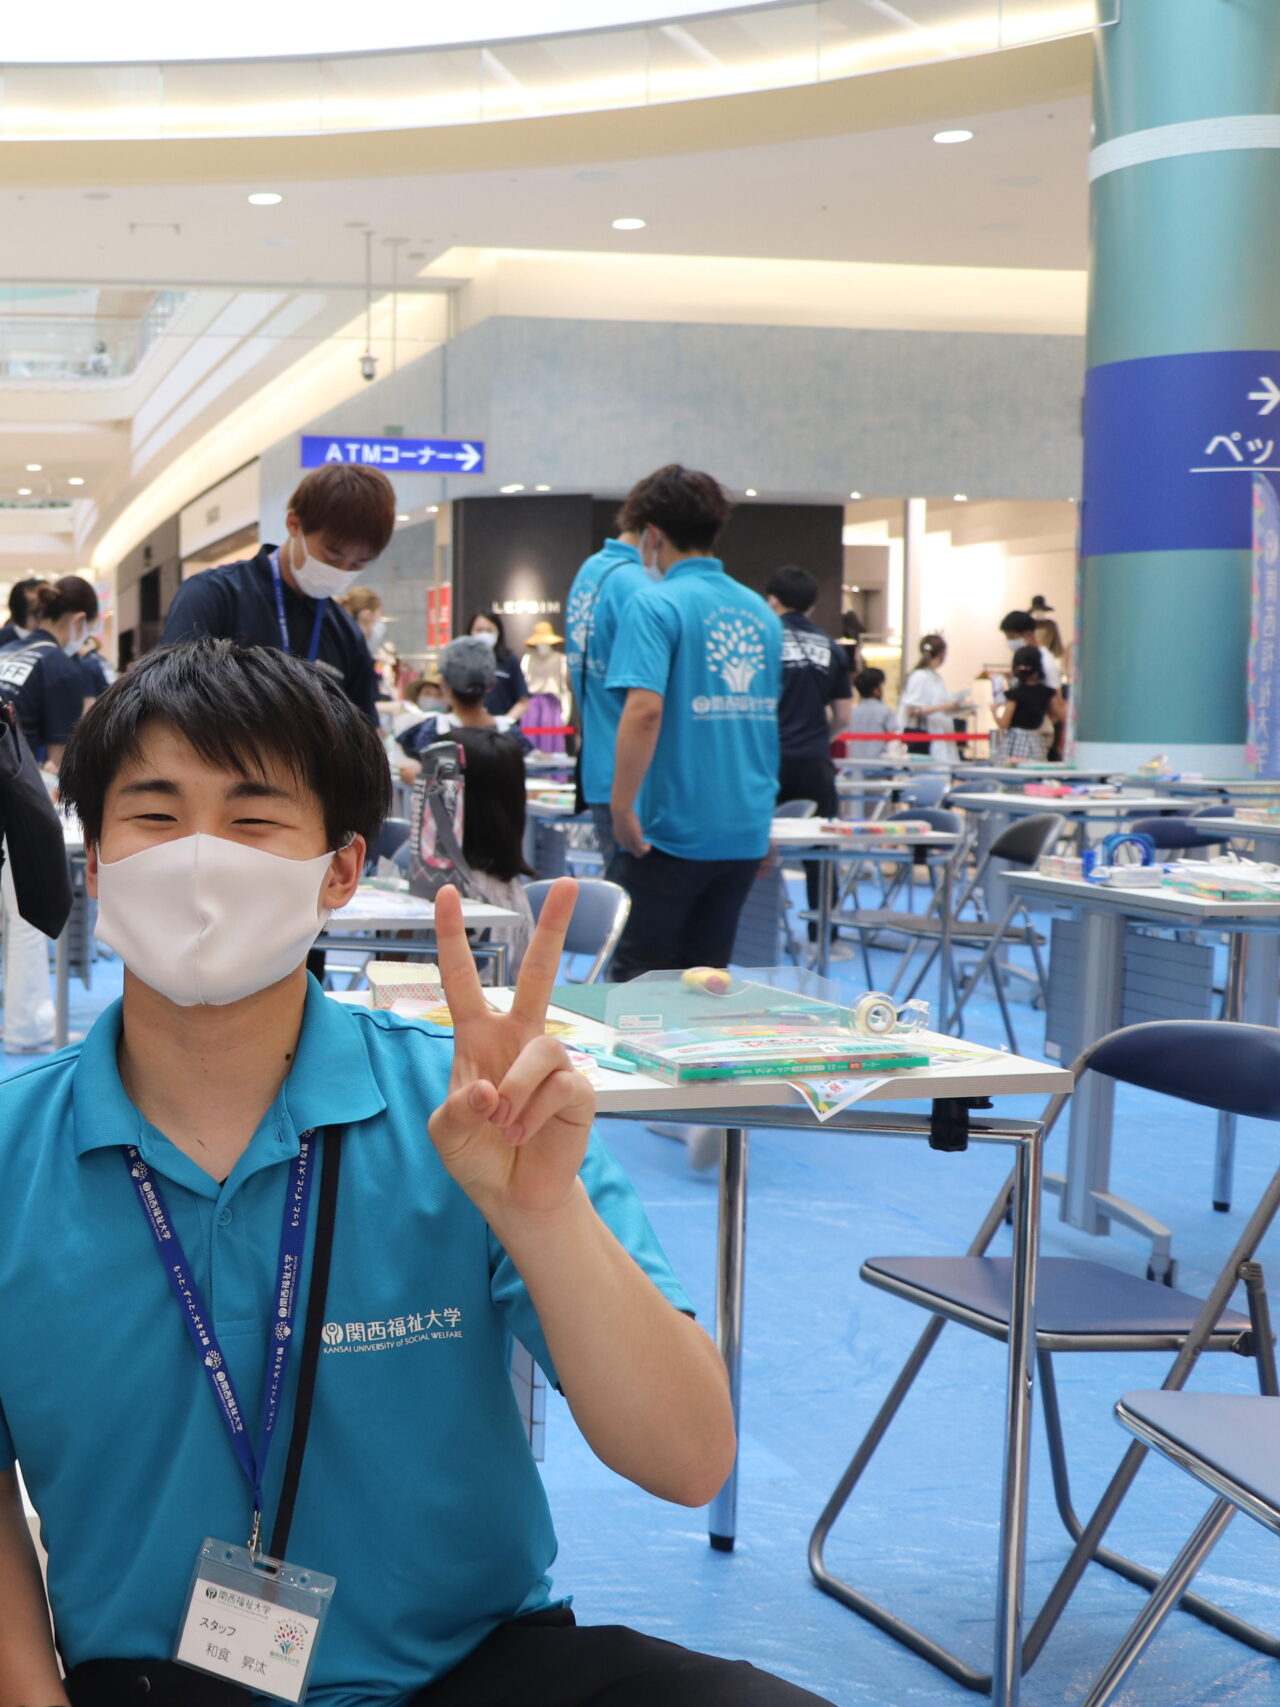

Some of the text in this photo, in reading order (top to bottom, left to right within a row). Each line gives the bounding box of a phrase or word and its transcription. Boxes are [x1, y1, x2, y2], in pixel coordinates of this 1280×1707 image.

[324, 442, 454, 466] ATMコーナー
[145, 1190, 172, 1240] 関西福祉大学
[279, 1253, 294, 1308] 関西福祉大学
[345, 1307, 462, 1343] 関西福祉大学
[323, 1330, 463, 1354] KANSAI UNIVERSITY of SOCIAL WELFARE
[219, 1590, 271, 1615] 関西福祉大学
[200, 1616, 236, 1637] スタッフ
[205, 1642, 231, 1663] 和食
